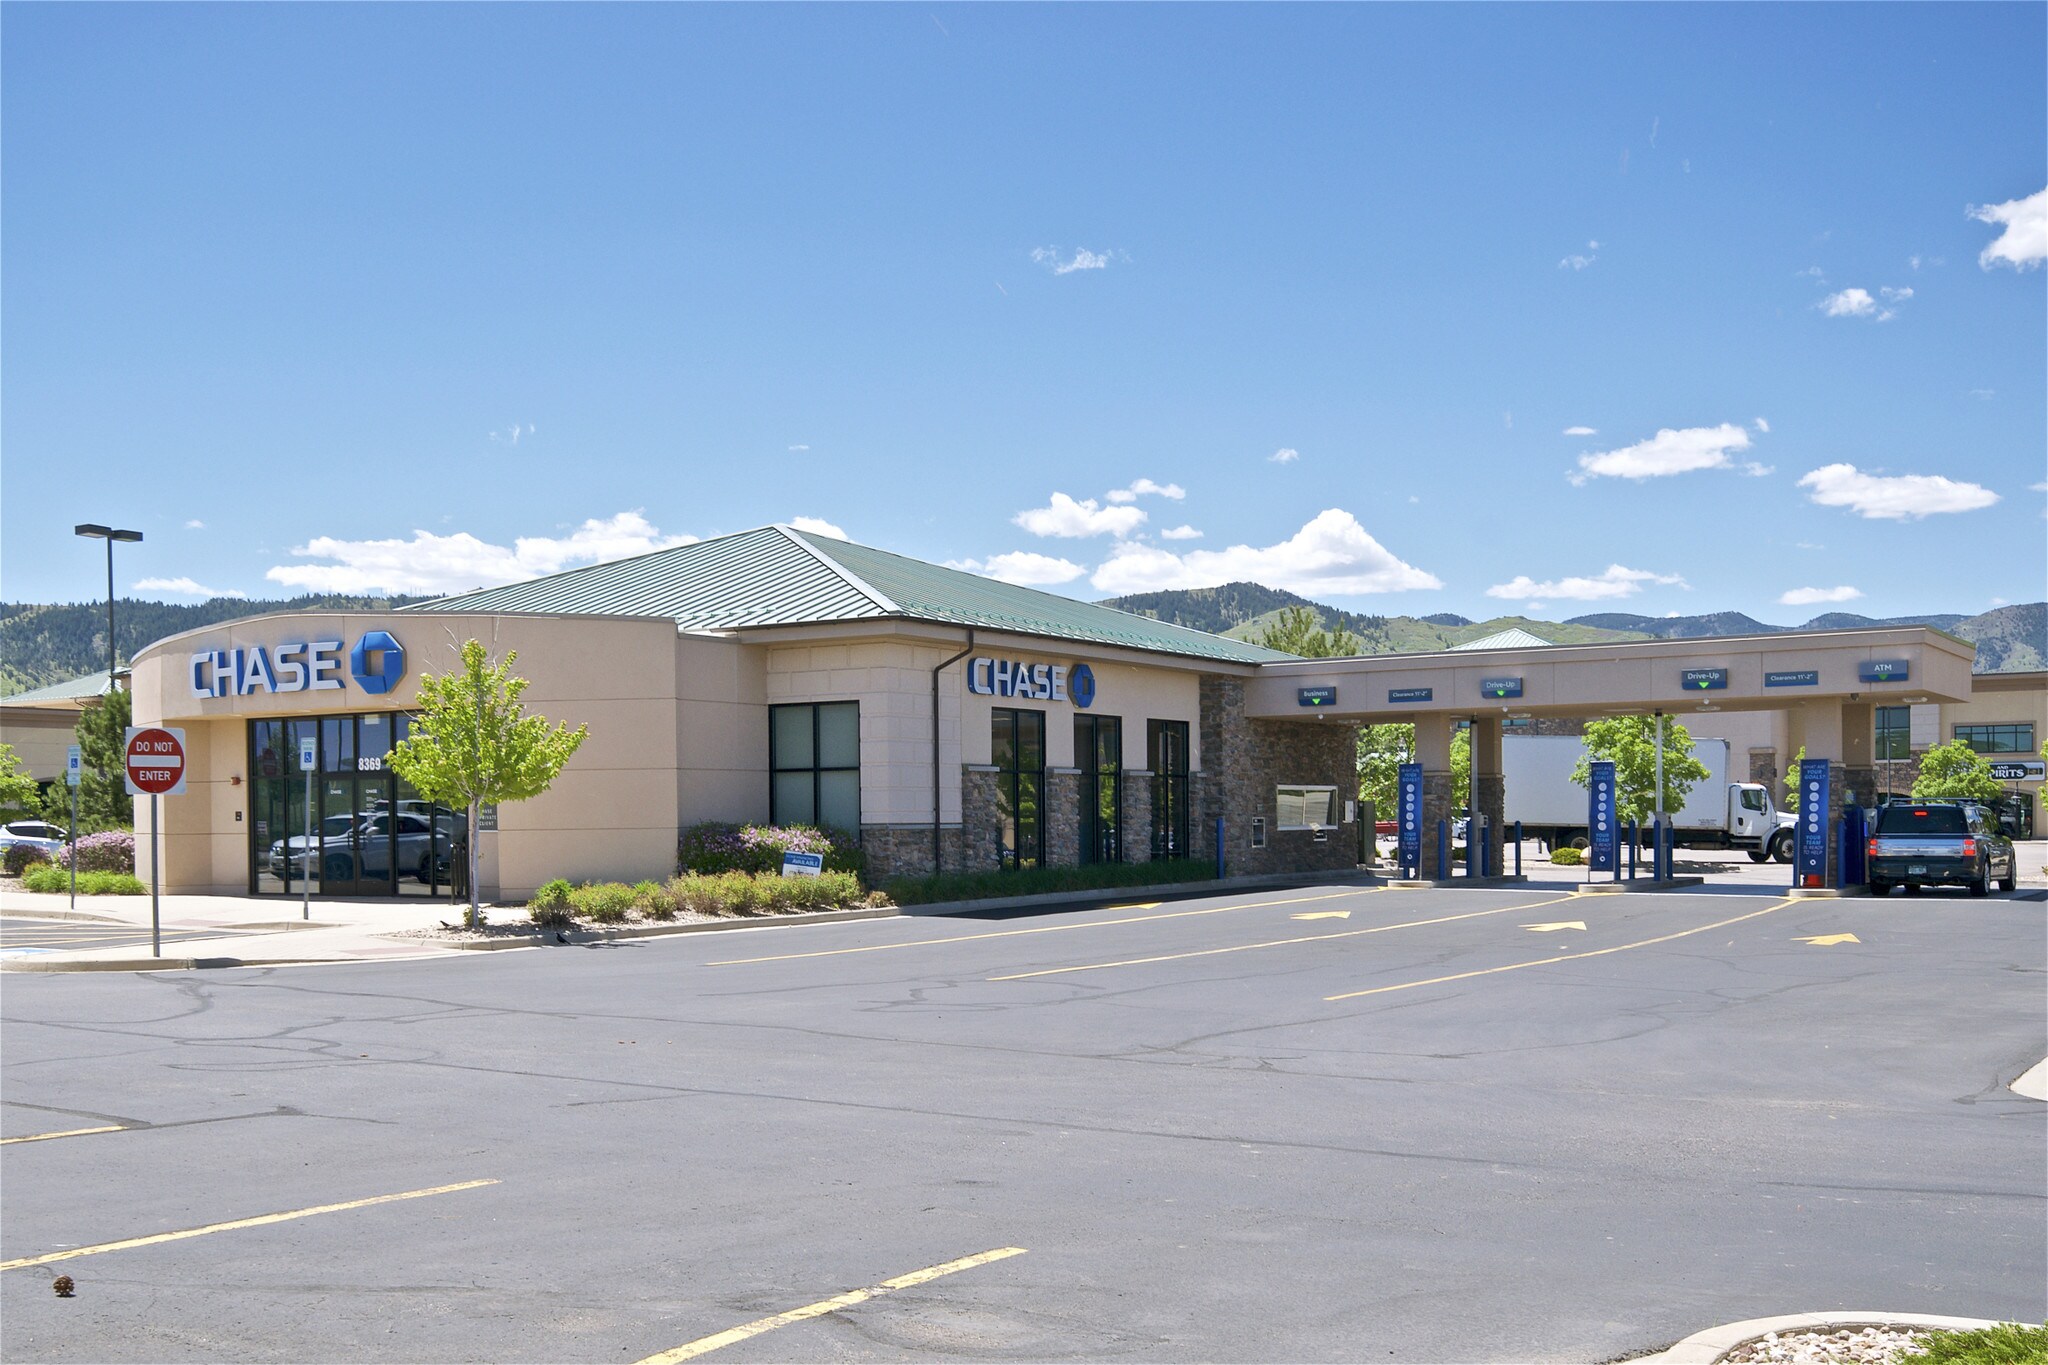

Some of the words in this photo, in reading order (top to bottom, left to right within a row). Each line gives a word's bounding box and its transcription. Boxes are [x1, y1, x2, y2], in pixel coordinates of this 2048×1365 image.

[190, 642, 344, 698] CHASE
[968, 657, 1067, 701] CHASE
[1687, 672, 1719, 680] Drive-Up
[136, 741, 150, 752] DO
[154, 741, 173, 752] NOT
[358, 757, 381, 771] 8369
[139, 770, 171, 781] ENTER
[1989, 769, 2025, 778] PIRITS
